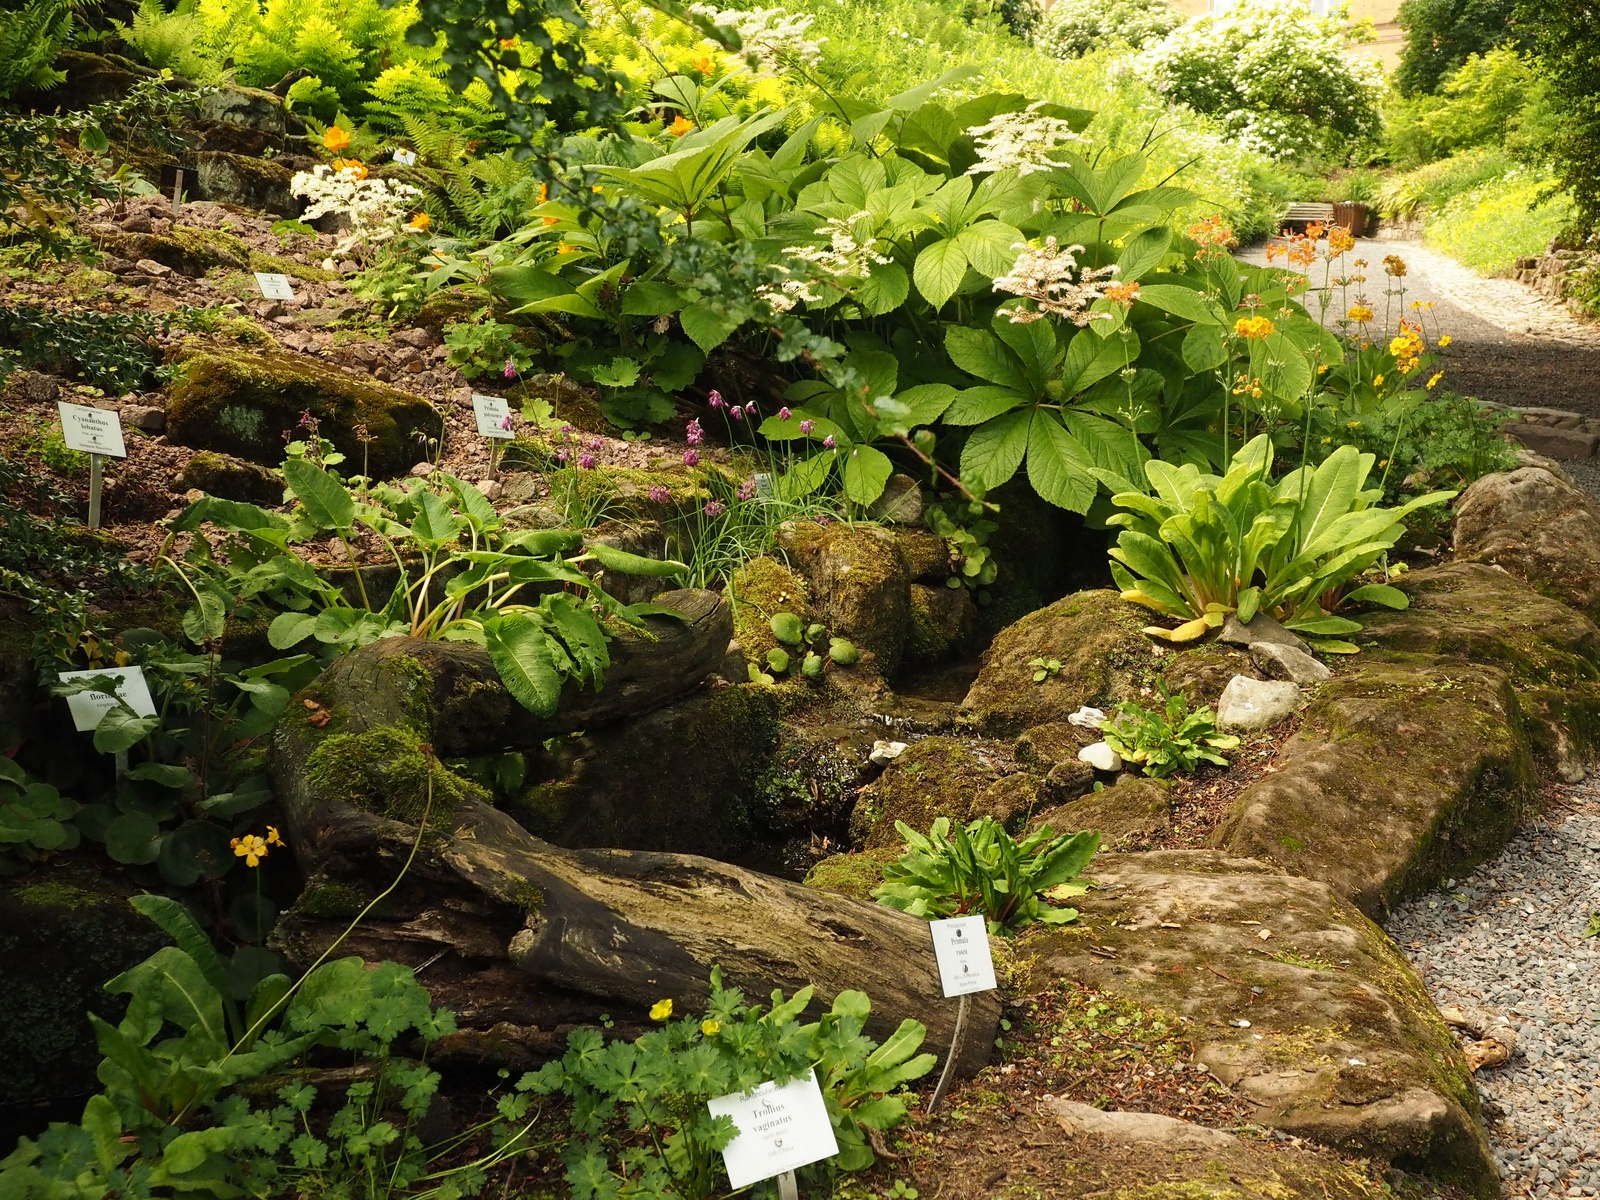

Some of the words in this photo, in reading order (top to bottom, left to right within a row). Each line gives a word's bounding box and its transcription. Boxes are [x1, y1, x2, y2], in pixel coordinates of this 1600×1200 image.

[72, 414, 109, 426] Cyananthus
[80, 423, 103, 432] lobatus
[951, 937, 969, 945] Primula
[751, 1103, 785, 1119] Trollius
[752, 1115, 793, 1133] vaginatus
